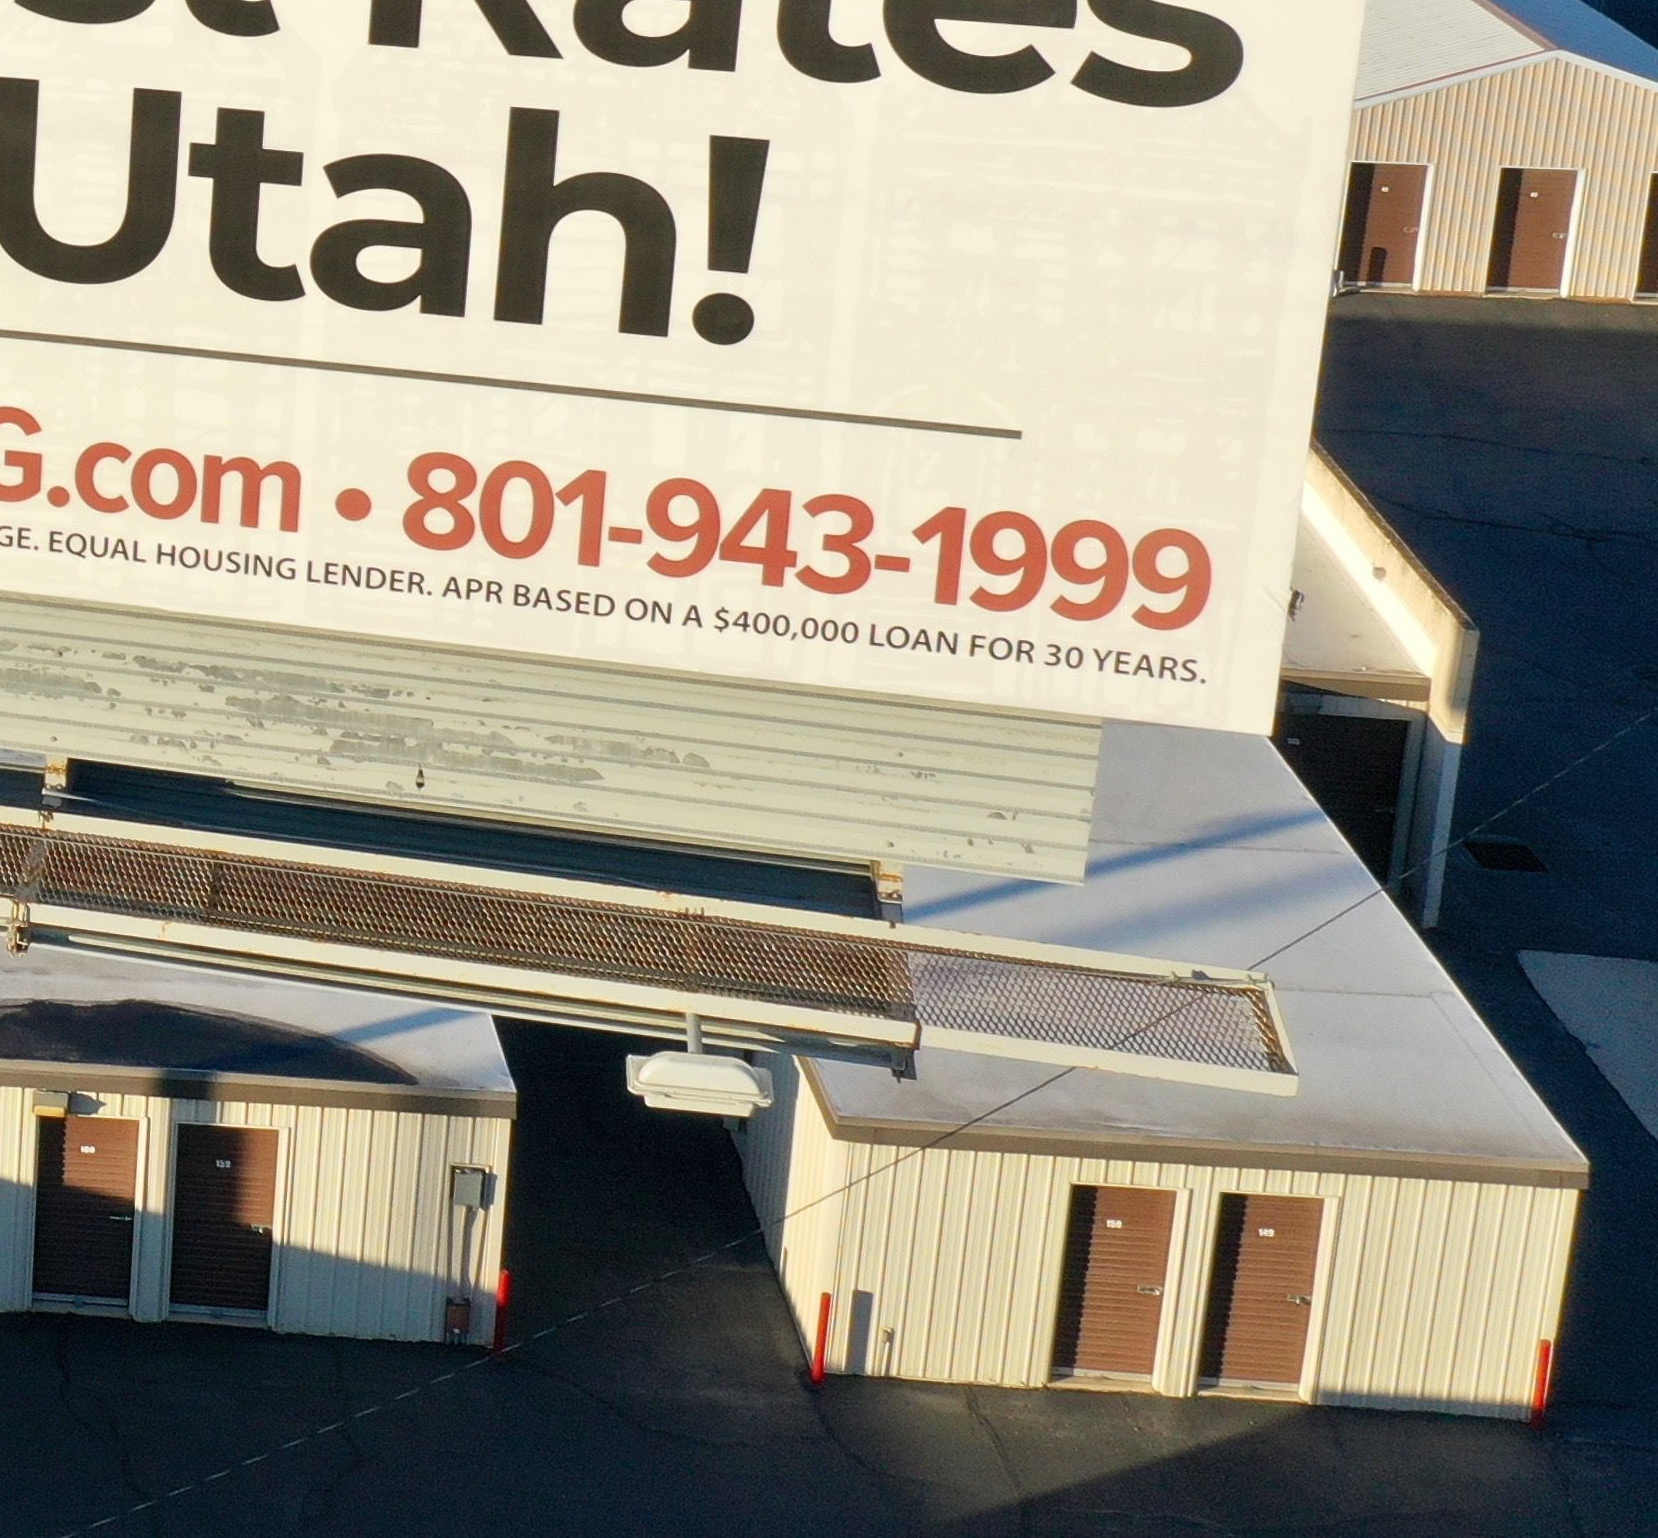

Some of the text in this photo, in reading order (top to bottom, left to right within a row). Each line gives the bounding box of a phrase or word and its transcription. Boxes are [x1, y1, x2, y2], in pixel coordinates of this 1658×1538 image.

[48, 530, 147, 563] EQUAL
[156, 543, 296, 581] HOUSING
[306, 560, 433, 597] LENDER.
[442, 576, 503, 604] APR
[512, 583, 616, 618] BASED
[625, 596, 672, 626] ON
[682, 604, 703, 629] A
[713, 605, 859, 645] $400,000
[869, 623, 959, 655] LOAN
[969, 634, 1035, 665] FOR
[1044, 643, 1084, 670] 30
[1092, 648, 1207, 684] YEARS.
[402, 451, 1212, 631] 801-943-1999
